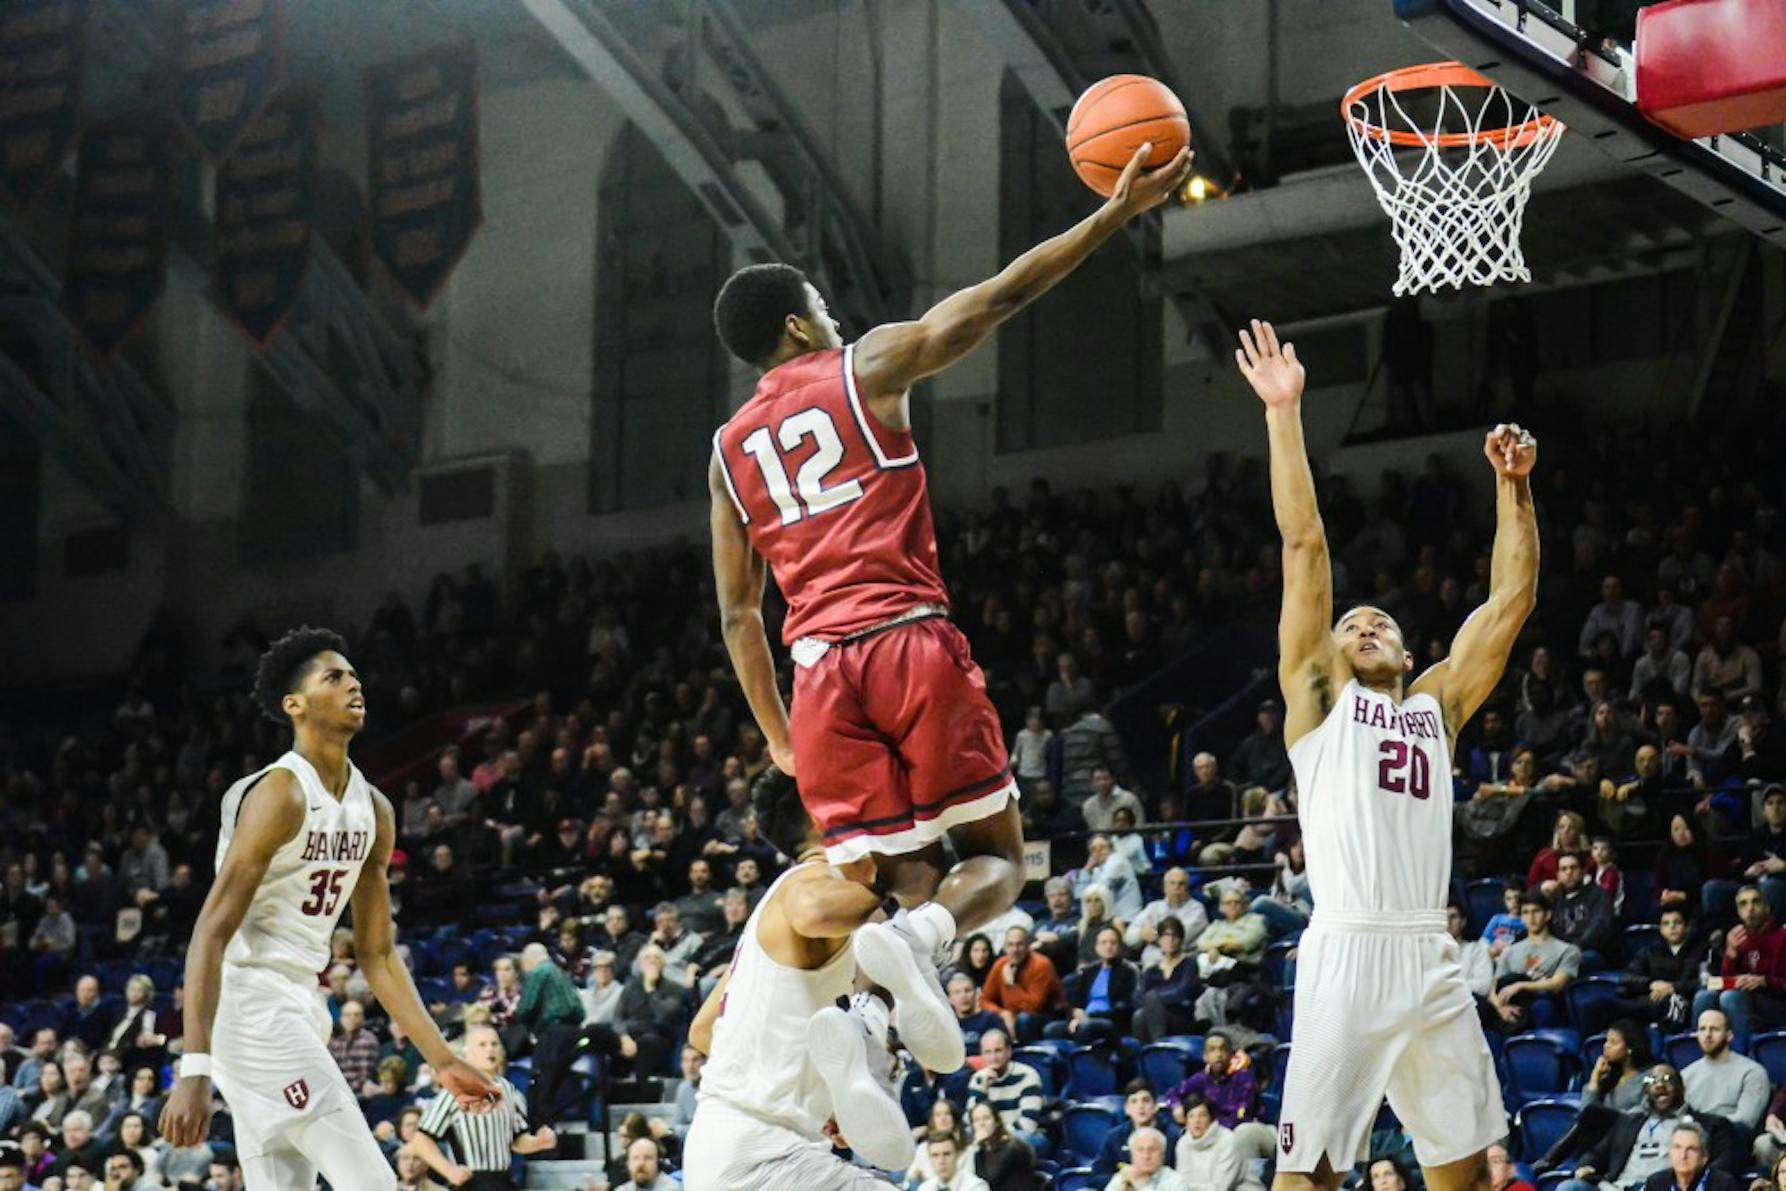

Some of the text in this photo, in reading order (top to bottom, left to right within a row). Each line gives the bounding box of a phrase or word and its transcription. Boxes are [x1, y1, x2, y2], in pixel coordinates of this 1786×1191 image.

[741, 406, 864, 527] 12
[1378, 739, 1430, 801] 20
[300, 831, 368, 861] HAVARD
[302, 869, 350, 916] 35
[286, 1082, 307, 1106] H
